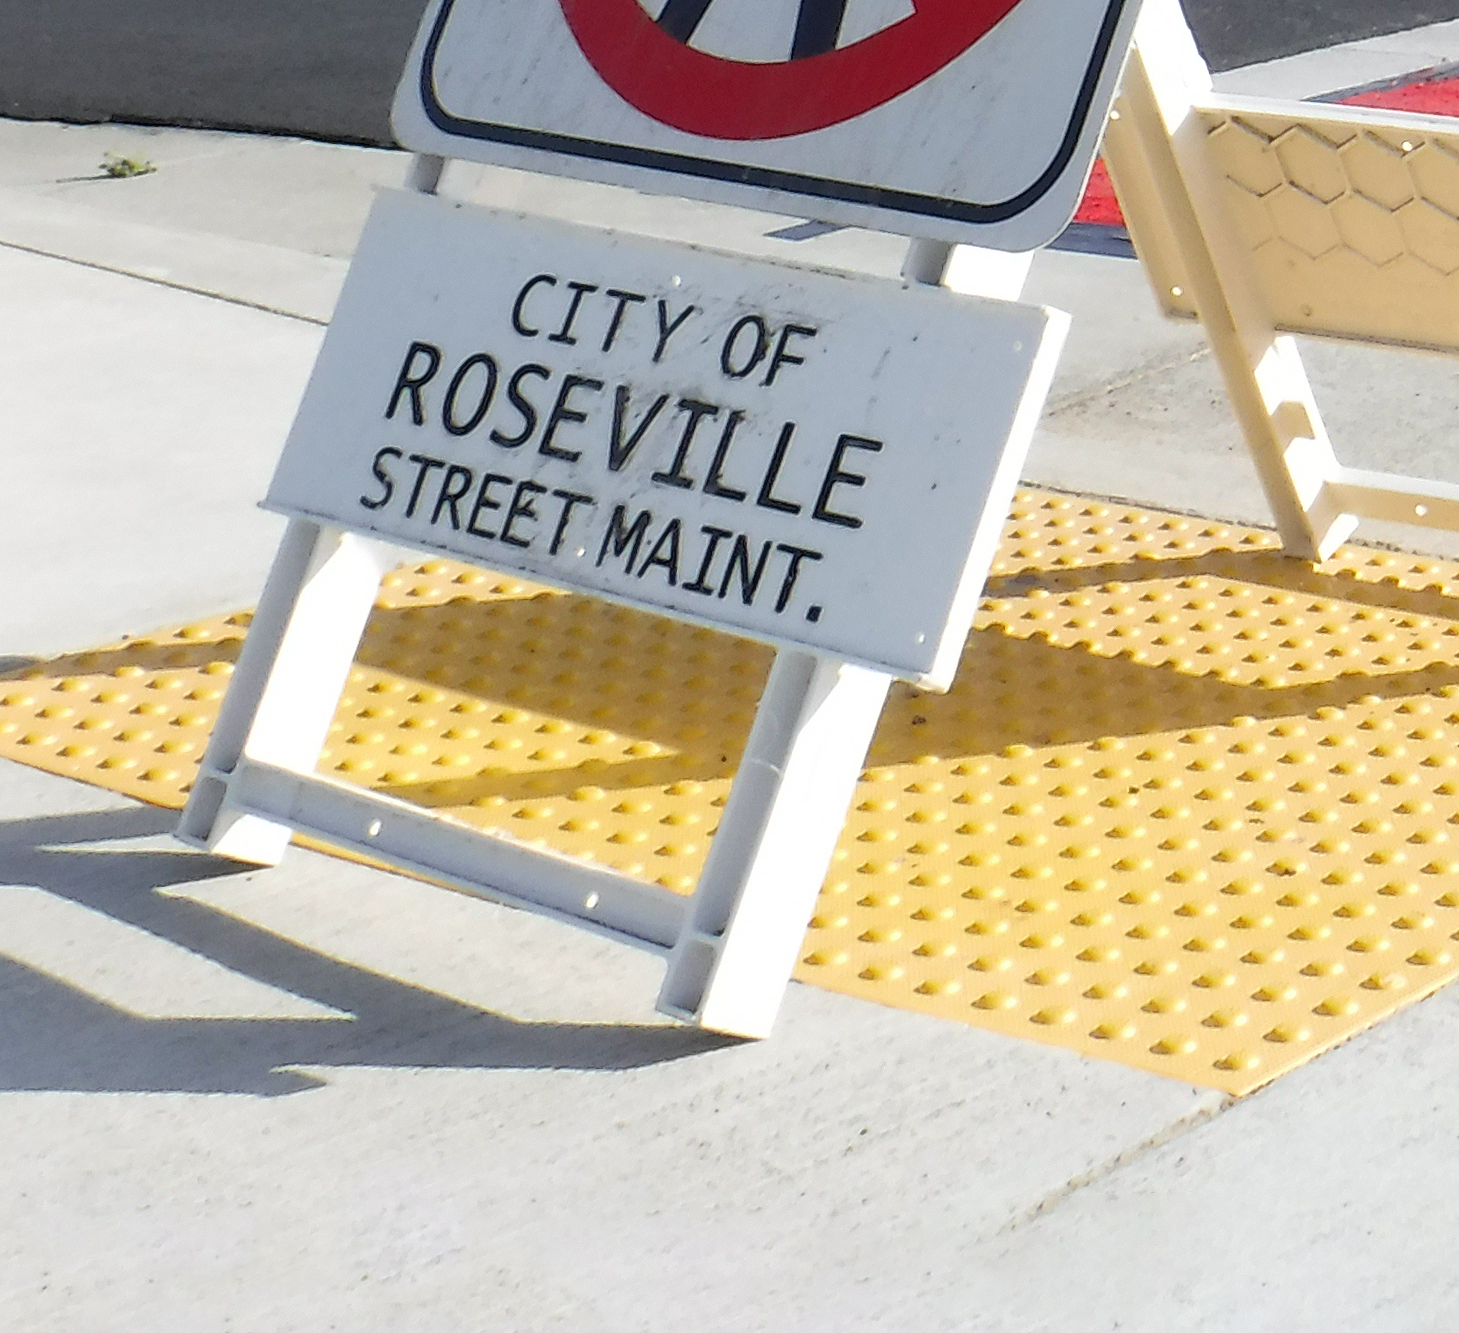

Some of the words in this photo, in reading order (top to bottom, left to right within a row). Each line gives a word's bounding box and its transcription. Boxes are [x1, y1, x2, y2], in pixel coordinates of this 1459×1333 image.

[511, 272, 703, 364] CITY
[720, 313, 818, 387] OF
[384, 341, 885, 529] ROSEVILLE
[359, 445, 594, 557] STREET
[594, 504, 824, 624] MAINT.
